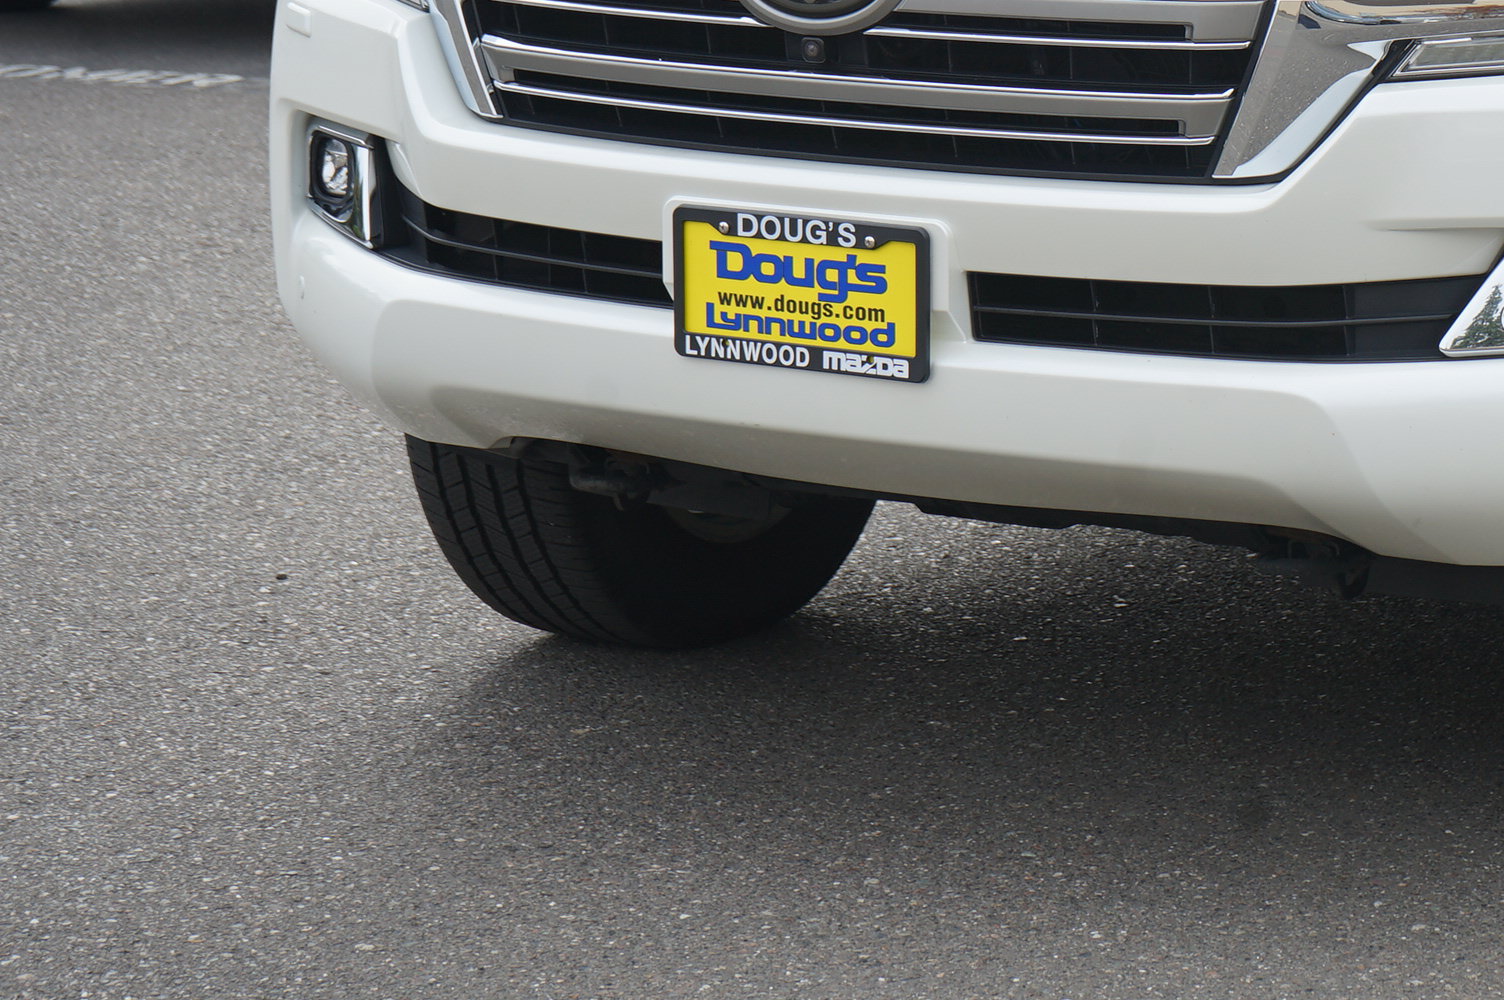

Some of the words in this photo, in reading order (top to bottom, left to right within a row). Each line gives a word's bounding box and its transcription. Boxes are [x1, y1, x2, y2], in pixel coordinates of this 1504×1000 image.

[736, 212, 858, 248] DOUG'S
[709, 240, 888, 304] Doug's
[706, 301, 896, 348] Lynnwood
[718, 291, 886, 323] www.dougs.com
[684, 334, 811, 368] LYNNWOOD
